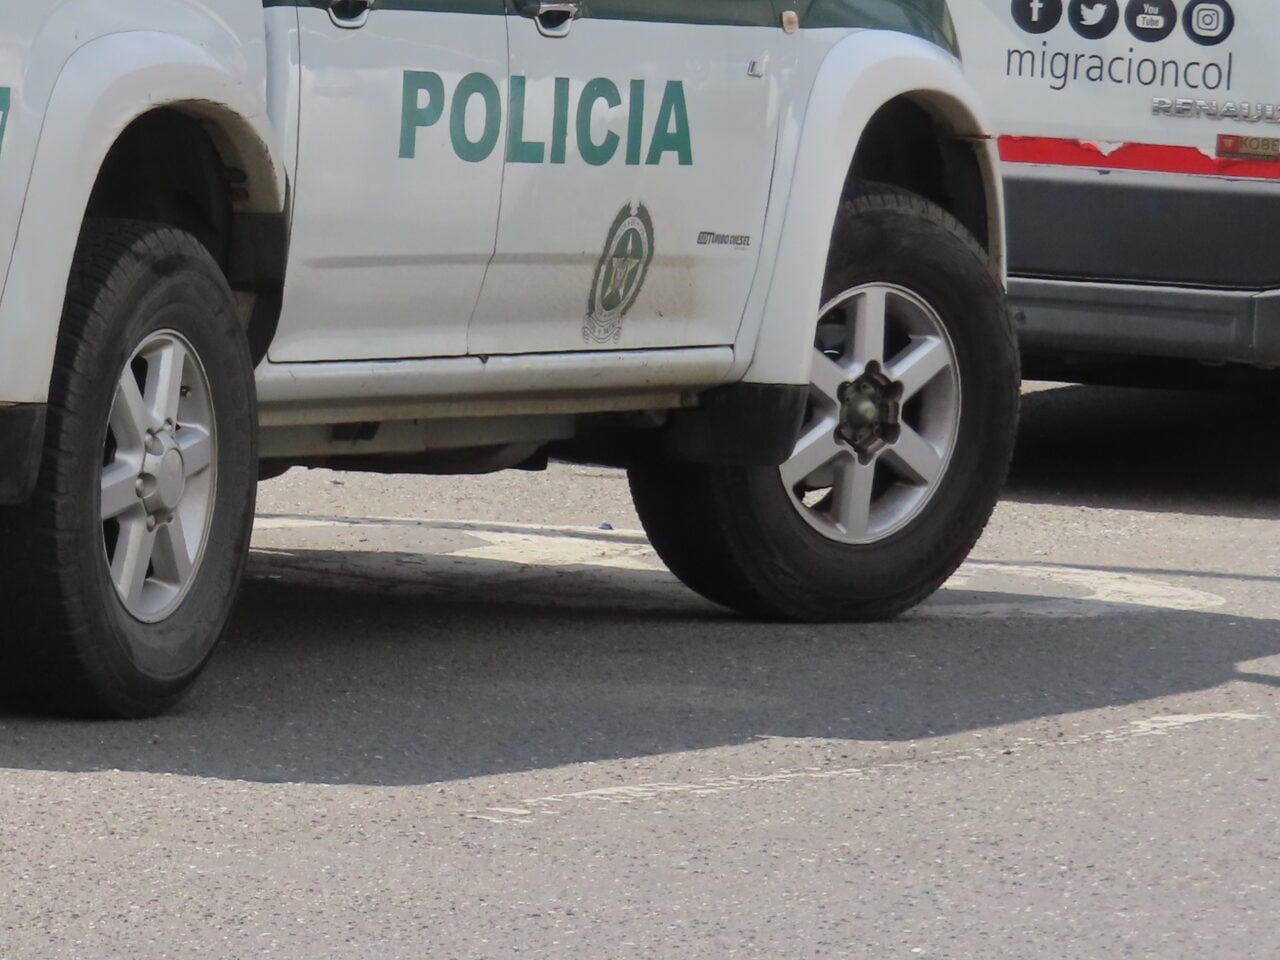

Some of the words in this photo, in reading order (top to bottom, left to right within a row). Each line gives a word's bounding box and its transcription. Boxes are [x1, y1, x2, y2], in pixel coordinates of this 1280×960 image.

[1140, 16, 1161, 27] Tube
[1143, 3, 1160, 15] You
[1006, 41, 1233, 90] migracioncol
[398, 70, 694, 166] POLICIA
[1151, 98, 1280, 124] RENAUL
